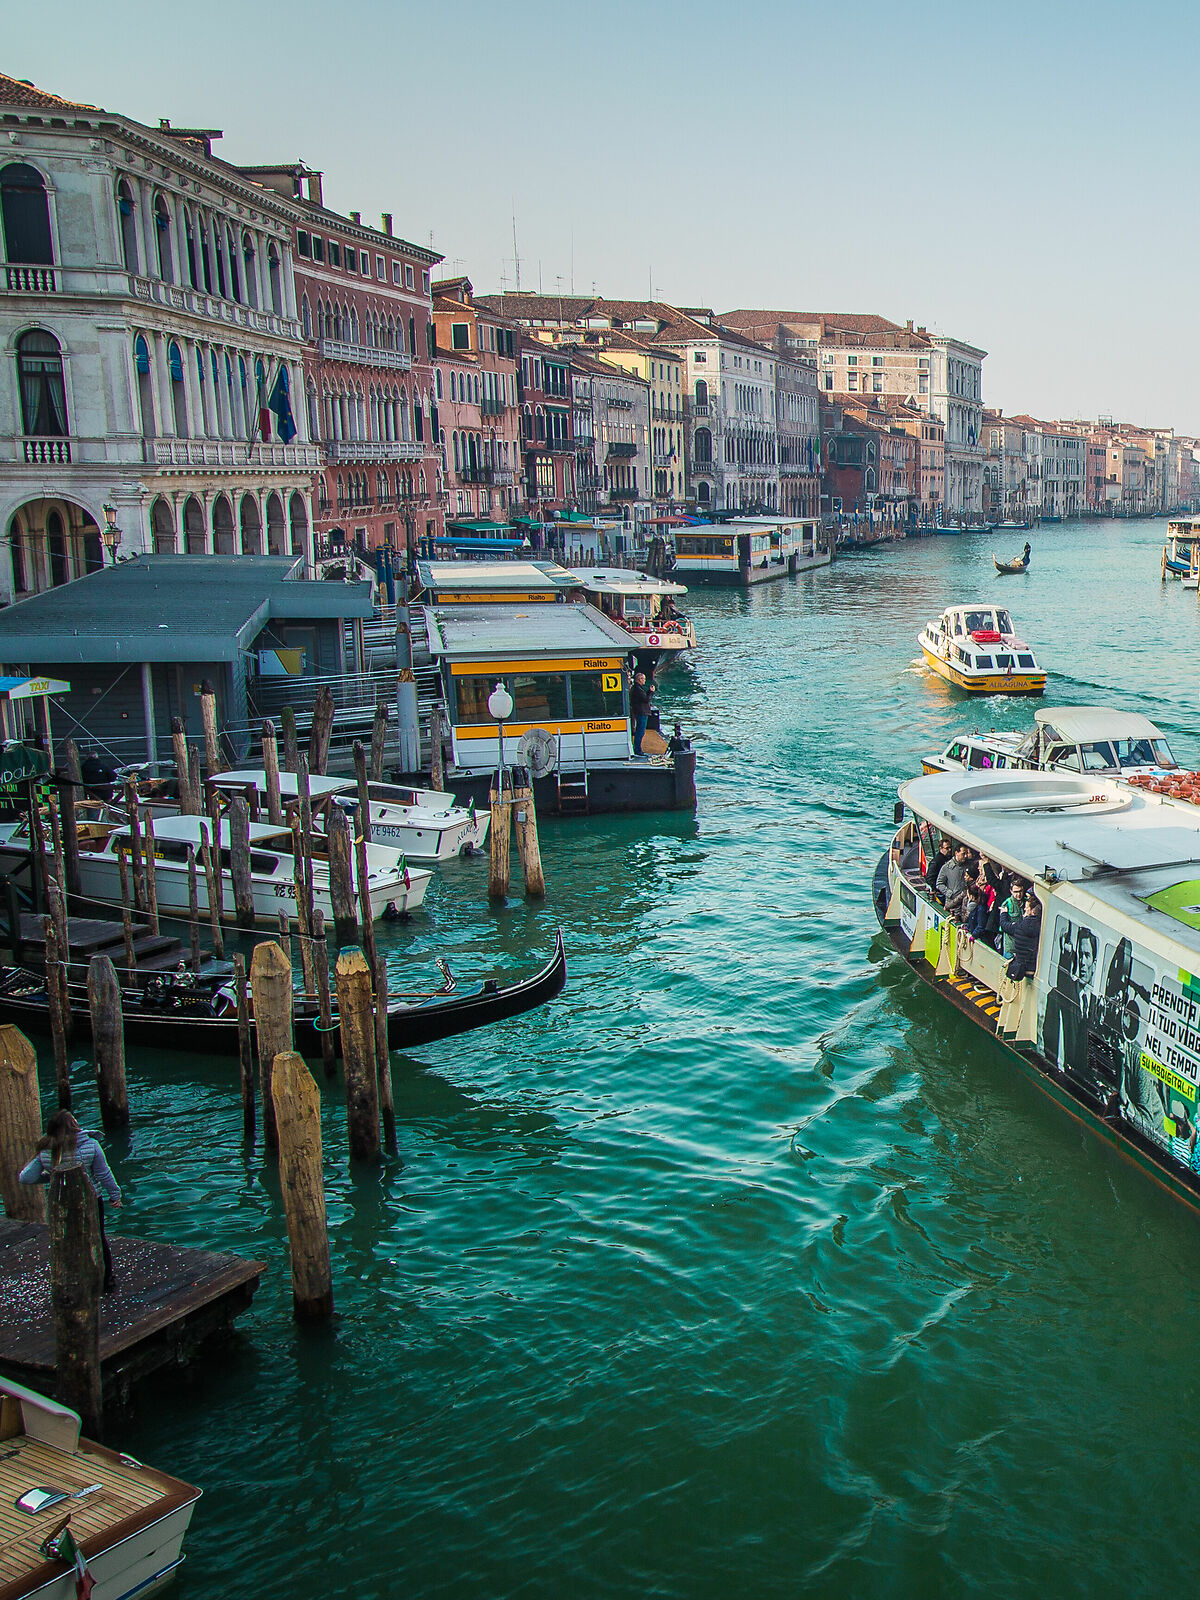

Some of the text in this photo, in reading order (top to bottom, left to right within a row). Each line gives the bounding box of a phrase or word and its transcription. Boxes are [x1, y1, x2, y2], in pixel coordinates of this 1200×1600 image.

[583, 660, 608, 668] Rialto
[29, 681, 50, 692] TAXI
[606, 676, 618, 689] D
[587, 723, 611, 731] Rialto
[1089, 794, 1105, 802] JRC
[371, 826, 401, 838] VE 9462
[1152, 983, 1197, 1022] PRENOTA
[1148, 1008, 1156, 1026] IL
[1158, 1013, 1177, 1039] TUO
[1145, 1033, 1198, 1080] NEL TEMPO
[1142, 1055, 1195, 1098] SU M9DIGITAL.IT
